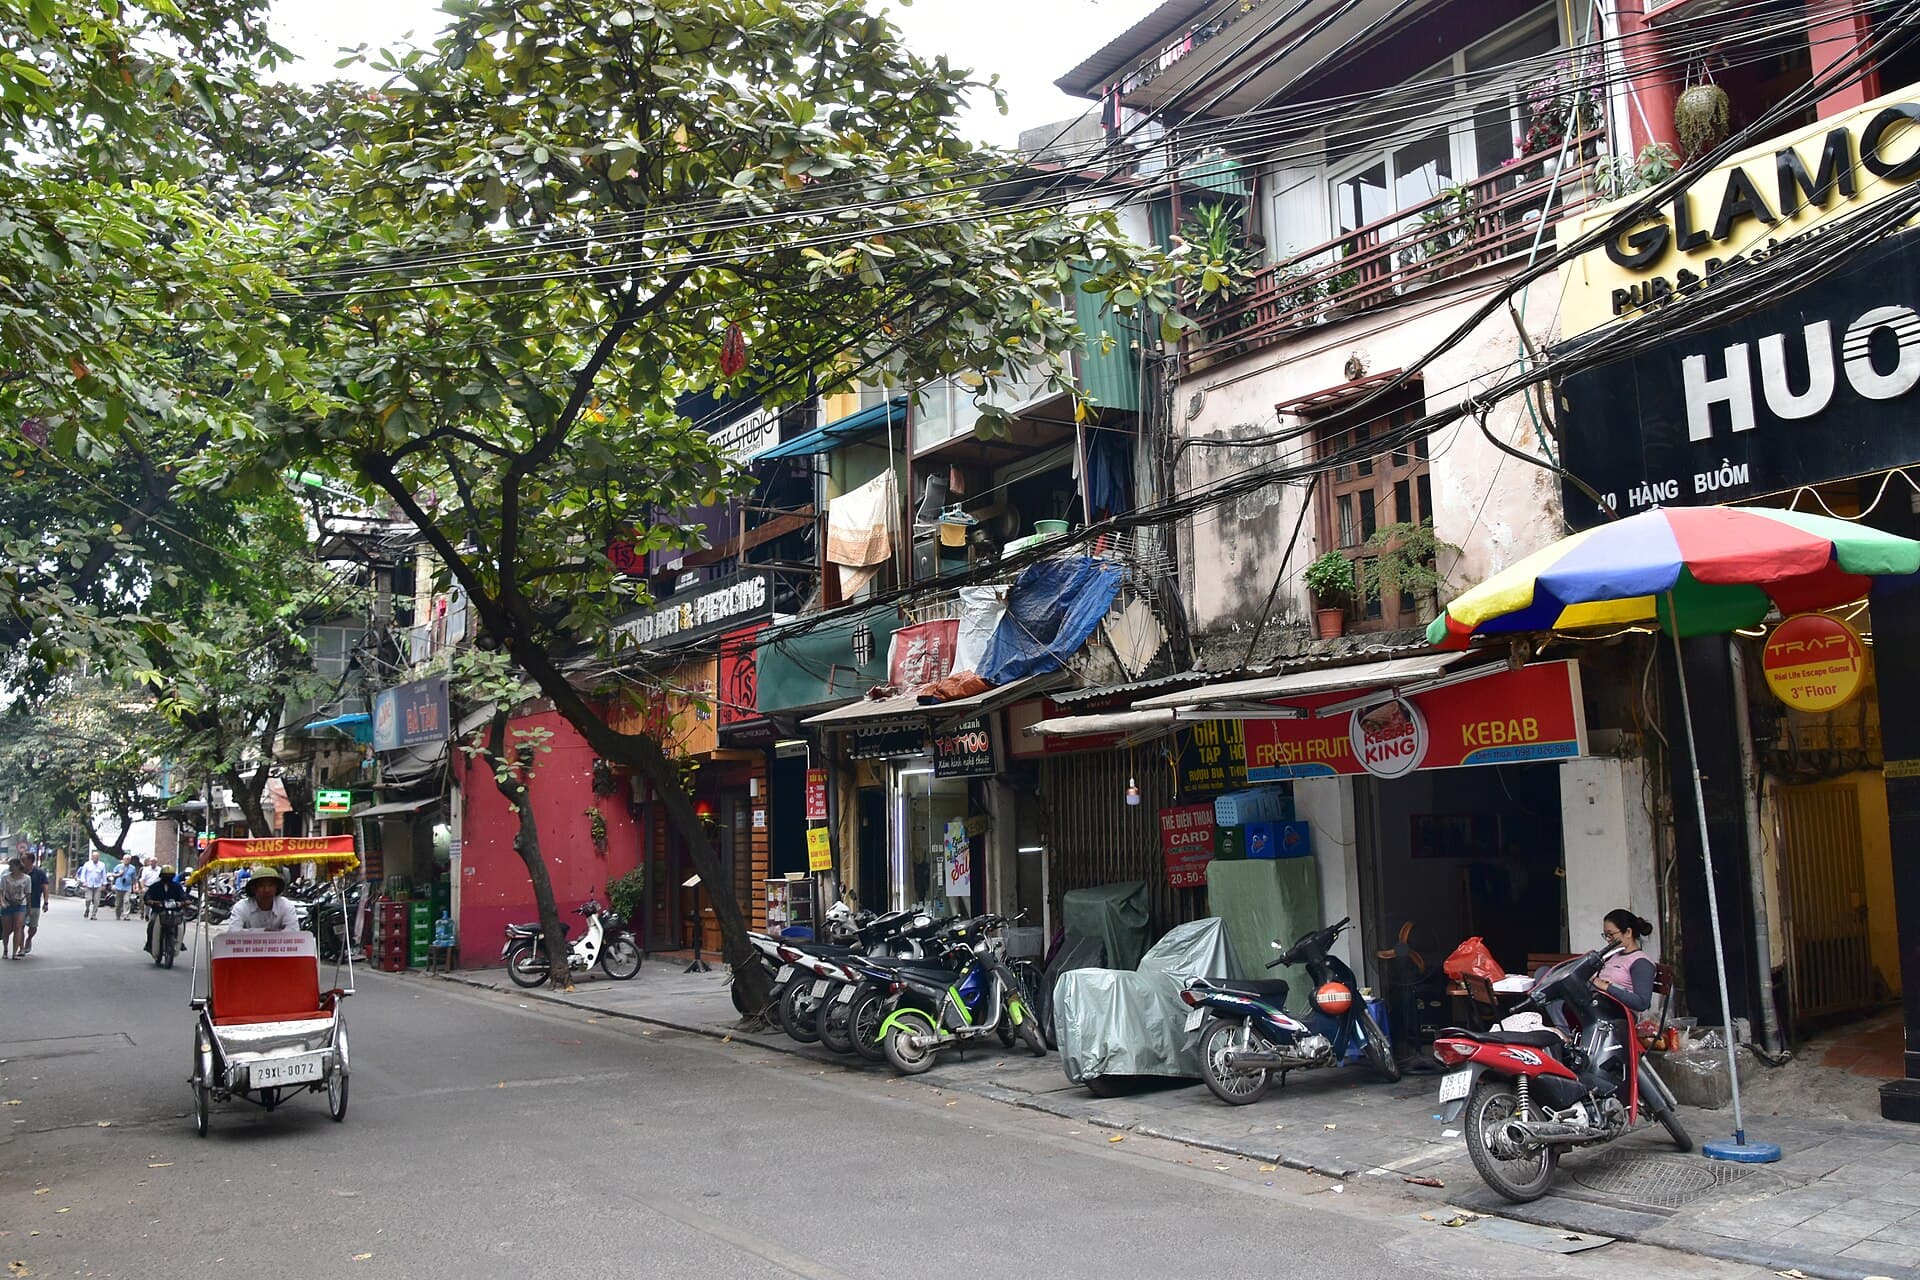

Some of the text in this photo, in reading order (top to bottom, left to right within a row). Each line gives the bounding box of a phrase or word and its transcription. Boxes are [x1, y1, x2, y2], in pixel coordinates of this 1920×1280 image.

[1605, 103, 1920, 269] GLAMO
[736, 411, 774, 448] STUDIO
[1628, 481, 1679, 508] HÀNG
[1694, 457, 1750, 494] BUỒM
[1768, 635, 1846, 656] TRAP
[1774, 665, 1850, 681] Real Life Escape Game
[1804, 685, 1837, 698] Floor
[935, 731, 990, 757] TATTOO
[1364, 721, 1415, 746] KEBAB
[1461, 717, 1539, 746] KEBAB
[1198, 747, 1221, 766] TẠP
[1256, 737, 1350, 765] FRESH FRUIT
[1364, 739, 1416, 766] KING
[246, 839, 329, 853] SANS SOUCI
[1171, 831, 1209, 846] CARD
